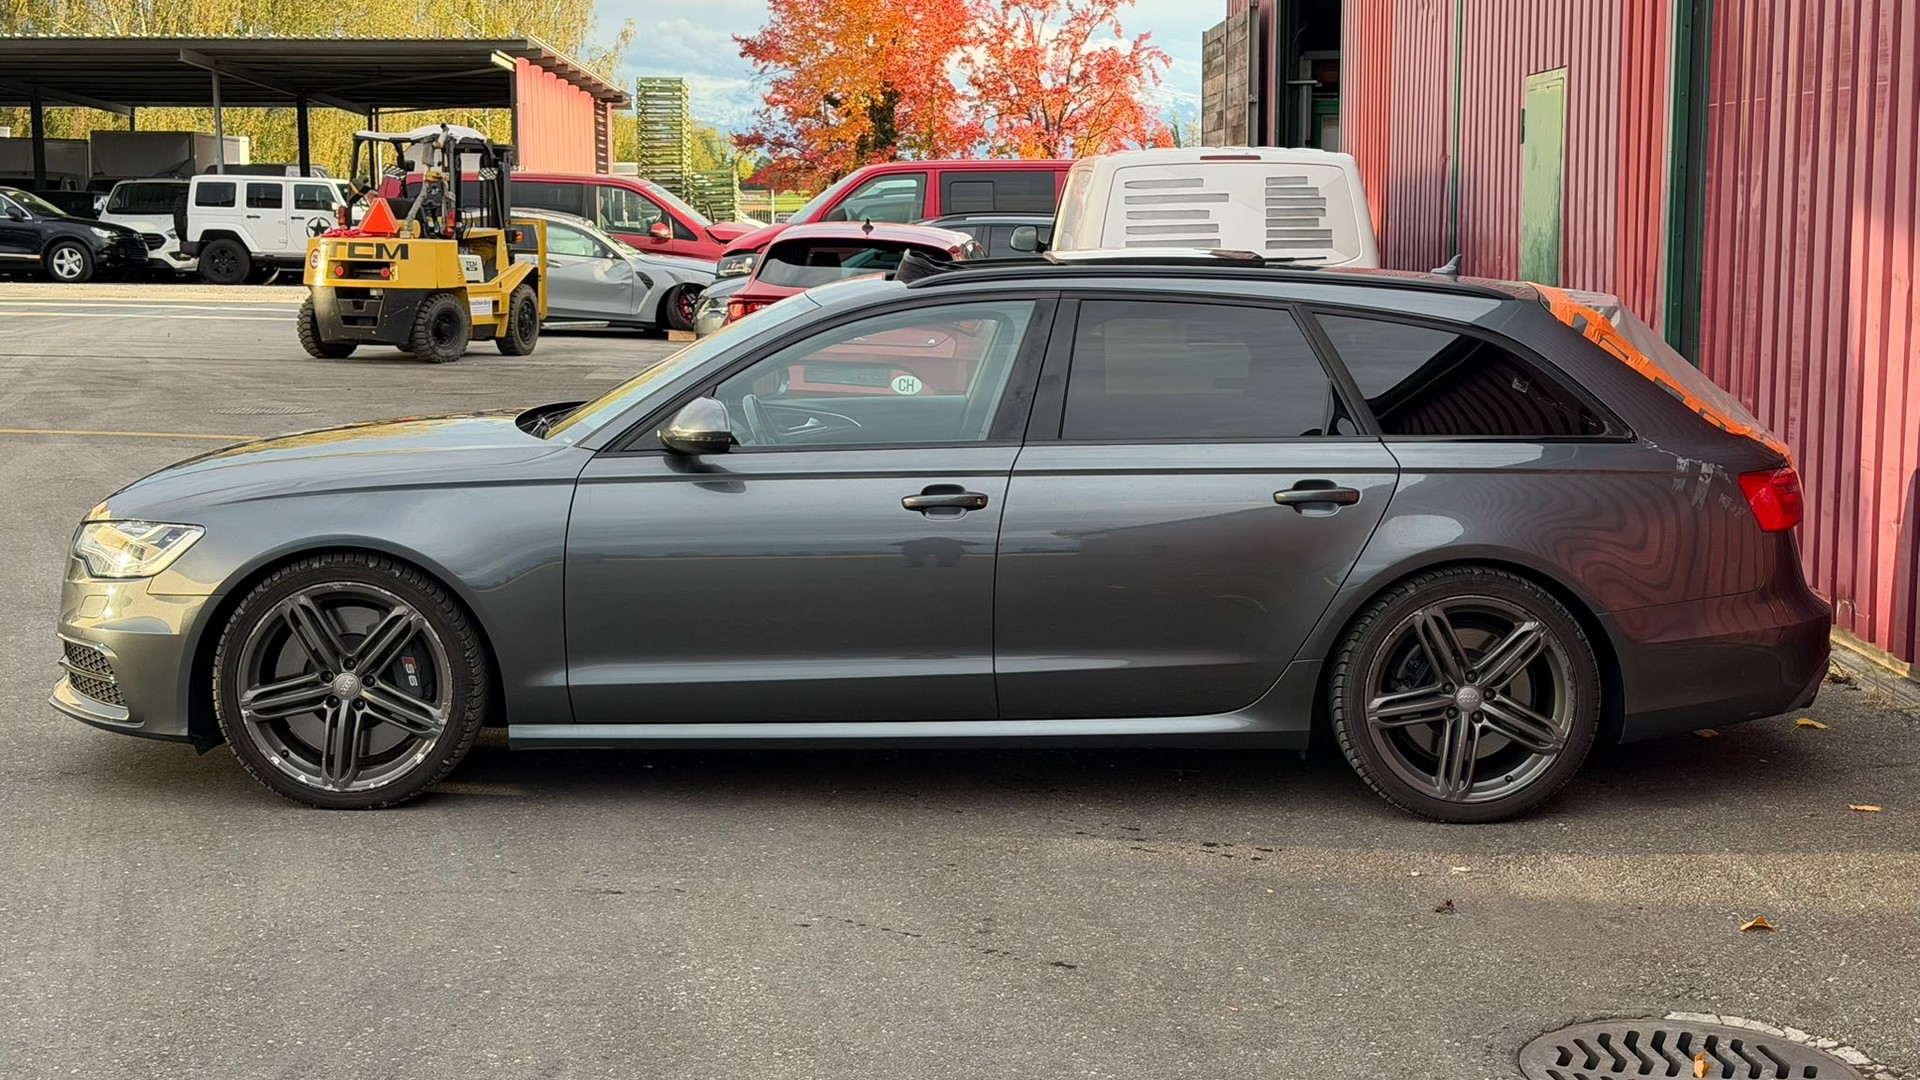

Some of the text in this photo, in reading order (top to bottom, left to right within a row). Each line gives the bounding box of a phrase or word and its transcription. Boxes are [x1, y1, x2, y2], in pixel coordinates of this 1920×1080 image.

[325, 241, 409, 260] TCM
[898, 378, 915, 392] CH
[405, 663, 418, 687] S6
